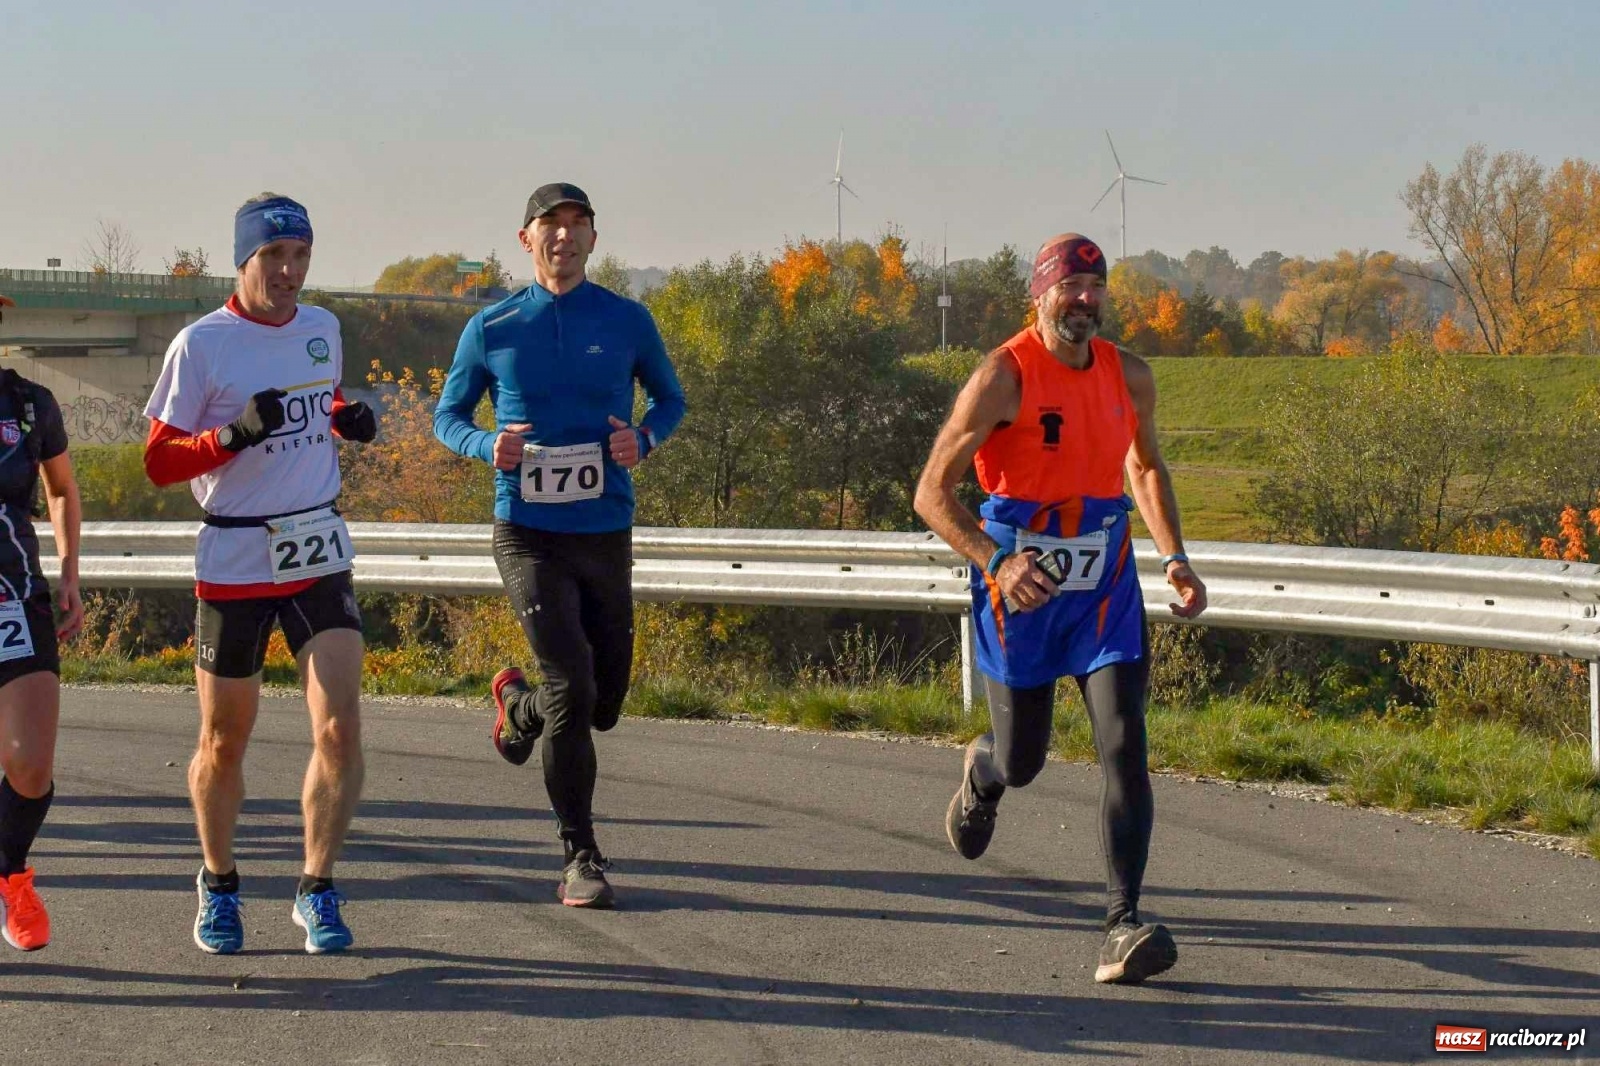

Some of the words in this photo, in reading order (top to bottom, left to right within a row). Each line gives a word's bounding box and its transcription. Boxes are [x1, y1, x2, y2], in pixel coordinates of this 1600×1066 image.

[269, 391, 333, 438] gro
[265, 434, 328, 454] KIETR
[528, 465, 599, 492] 170
[276, 530, 343, 571] 221
